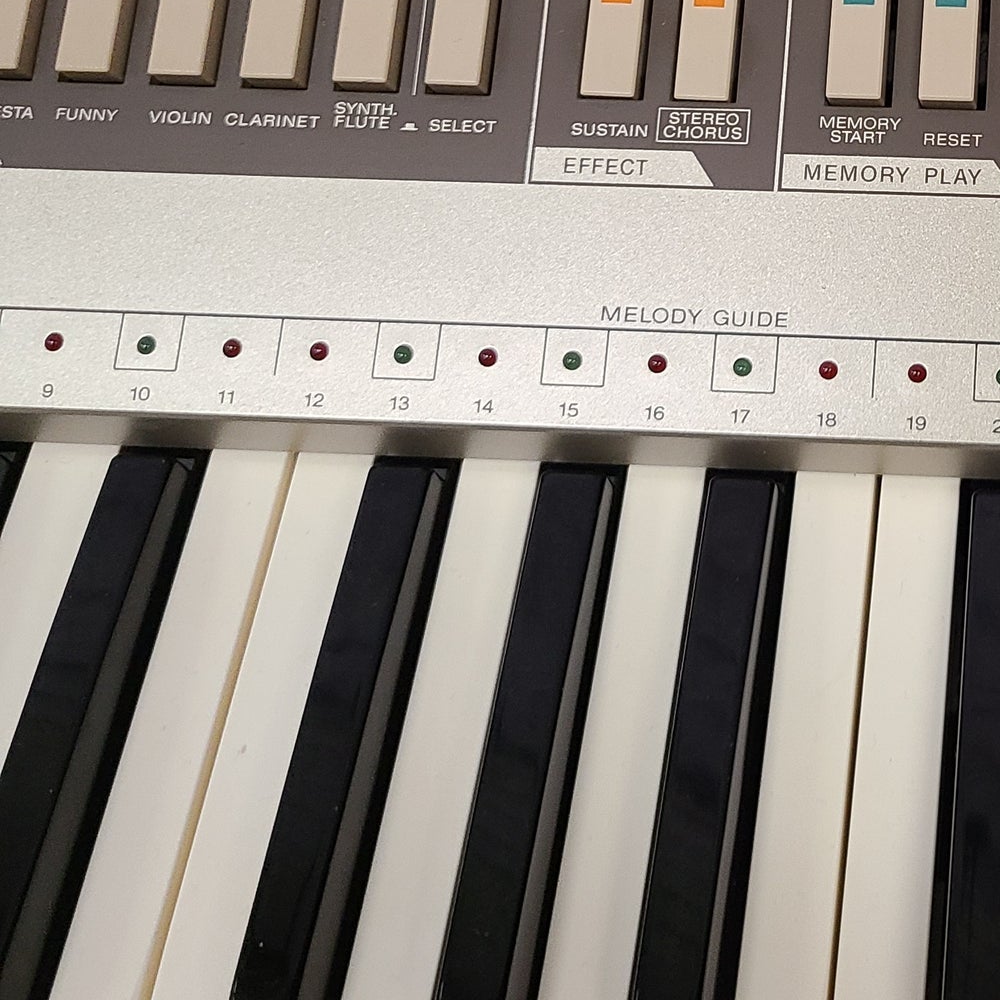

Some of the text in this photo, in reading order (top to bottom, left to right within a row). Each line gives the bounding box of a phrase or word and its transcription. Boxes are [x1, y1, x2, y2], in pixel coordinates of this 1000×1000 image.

[55, 107, 119, 122] FUNNY
[335, 101, 398, 116] SYNTH.
[149, 110, 212, 125] VIOLIN
[225, 112, 321, 129] CLARINET
[334, 114, 391, 129] FLUTE
[668, 111, 740, 126] STEREO
[819, 116, 902, 131] MEMORY
[429, 118, 497, 133] SELECT
[571, 122, 648, 138] SUSTAIN
[662, 125, 743, 140] CHORUS
[830, 129, 886, 144] START
[923, 133, 983, 147] RESET
[563, 157, 649, 176] EFFECT
[803, 163, 982, 186] MEMORY PLAY
[600, 305, 789, 328] MELODY GUIDE
[41, 383, 54, 398] 9
[130, 386, 151, 401] 10
[218, 389, 235, 404] 11
[305, 393, 324, 407] 12
[389, 395, 410, 411] 13
[474, 399, 494, 414] 14
[559, 402, 579, 418] 15
[645, 405, 665, 421] 16
[731, 408, 751, 424] 17
[817, 412, 837, 428] 18
[906, 416, 927, 431] 19
